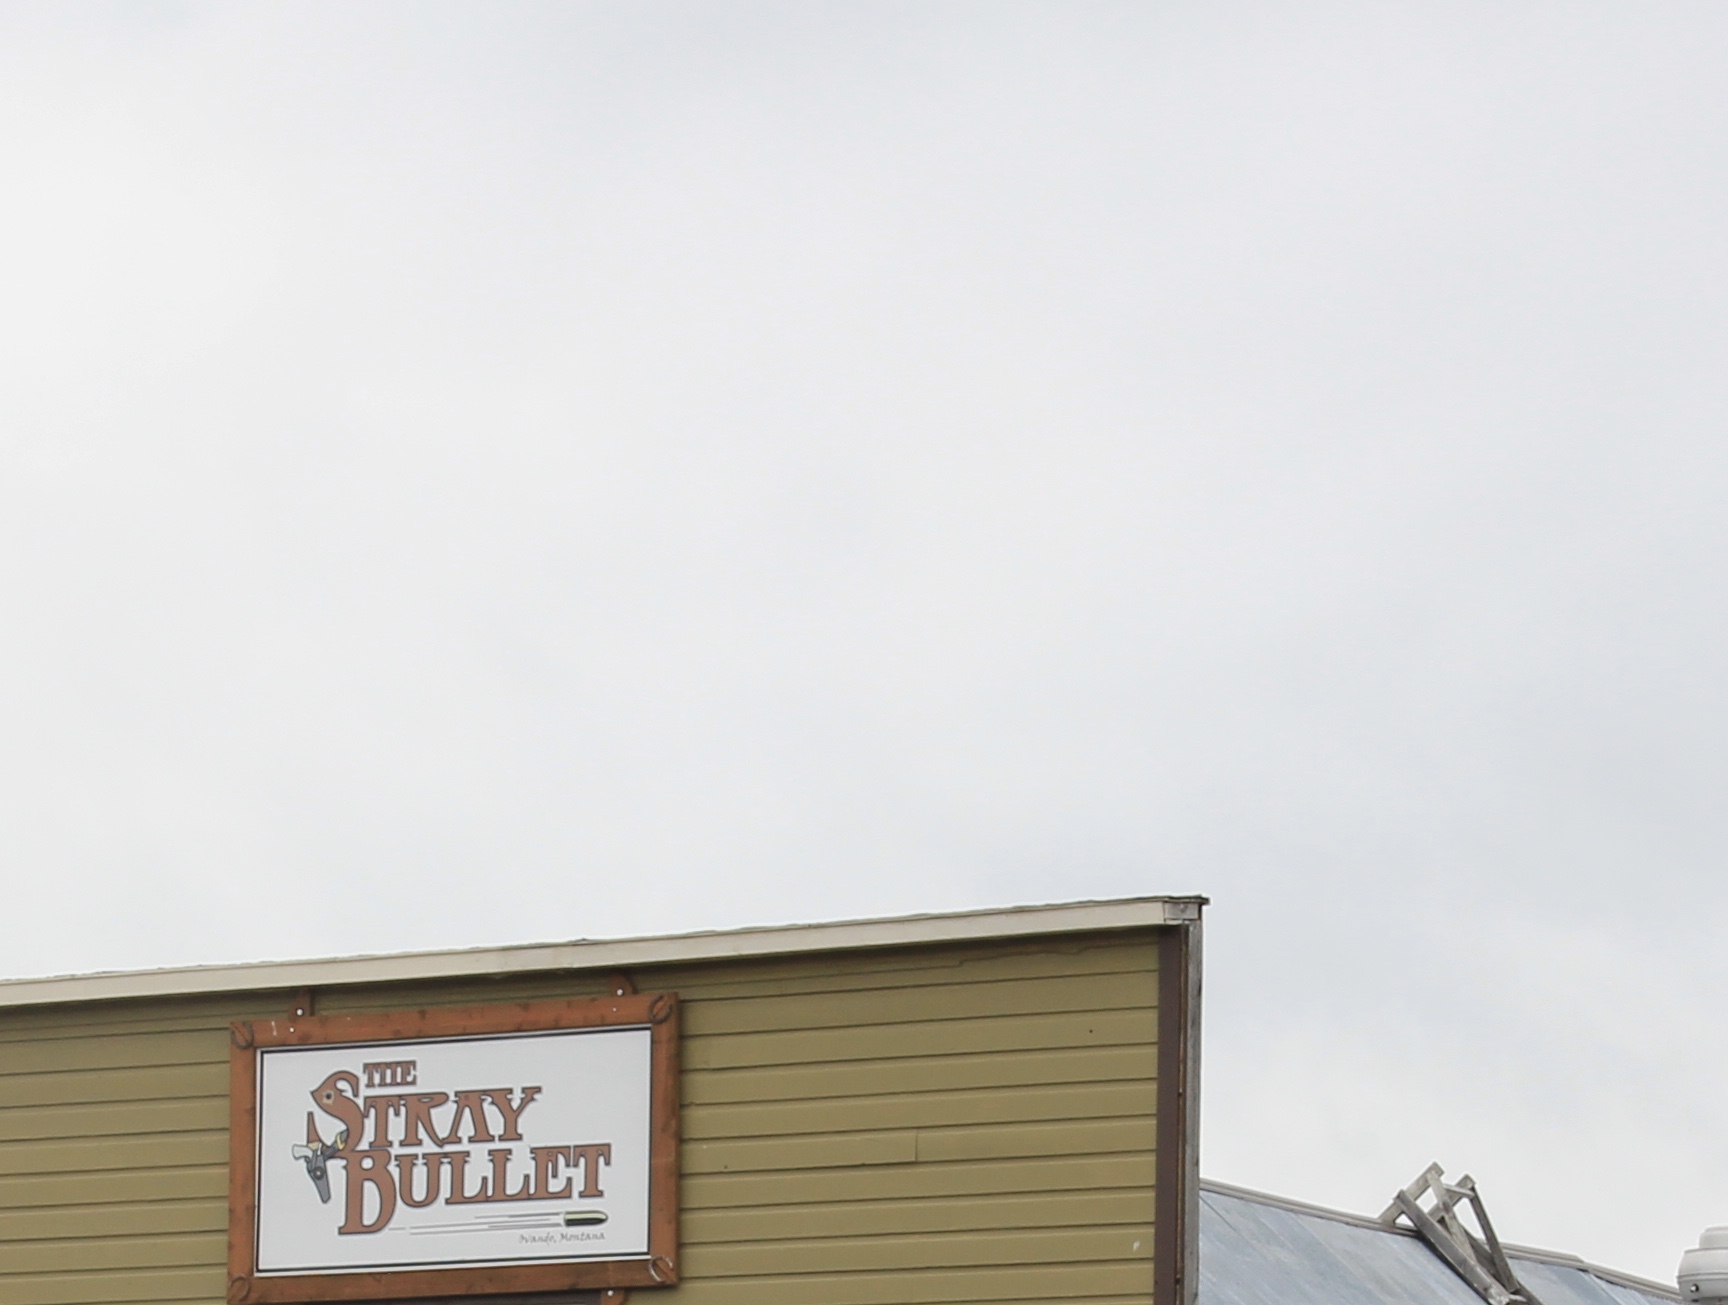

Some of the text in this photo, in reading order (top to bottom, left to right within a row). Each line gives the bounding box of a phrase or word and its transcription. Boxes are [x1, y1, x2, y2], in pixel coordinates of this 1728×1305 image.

[363, 1060, 417, 1088] THE
[308, 1070, 543, 1158] STRAY
[337, 1143, 612, 1236] BULLET
[560, 1231, 606, 1242] Montana
